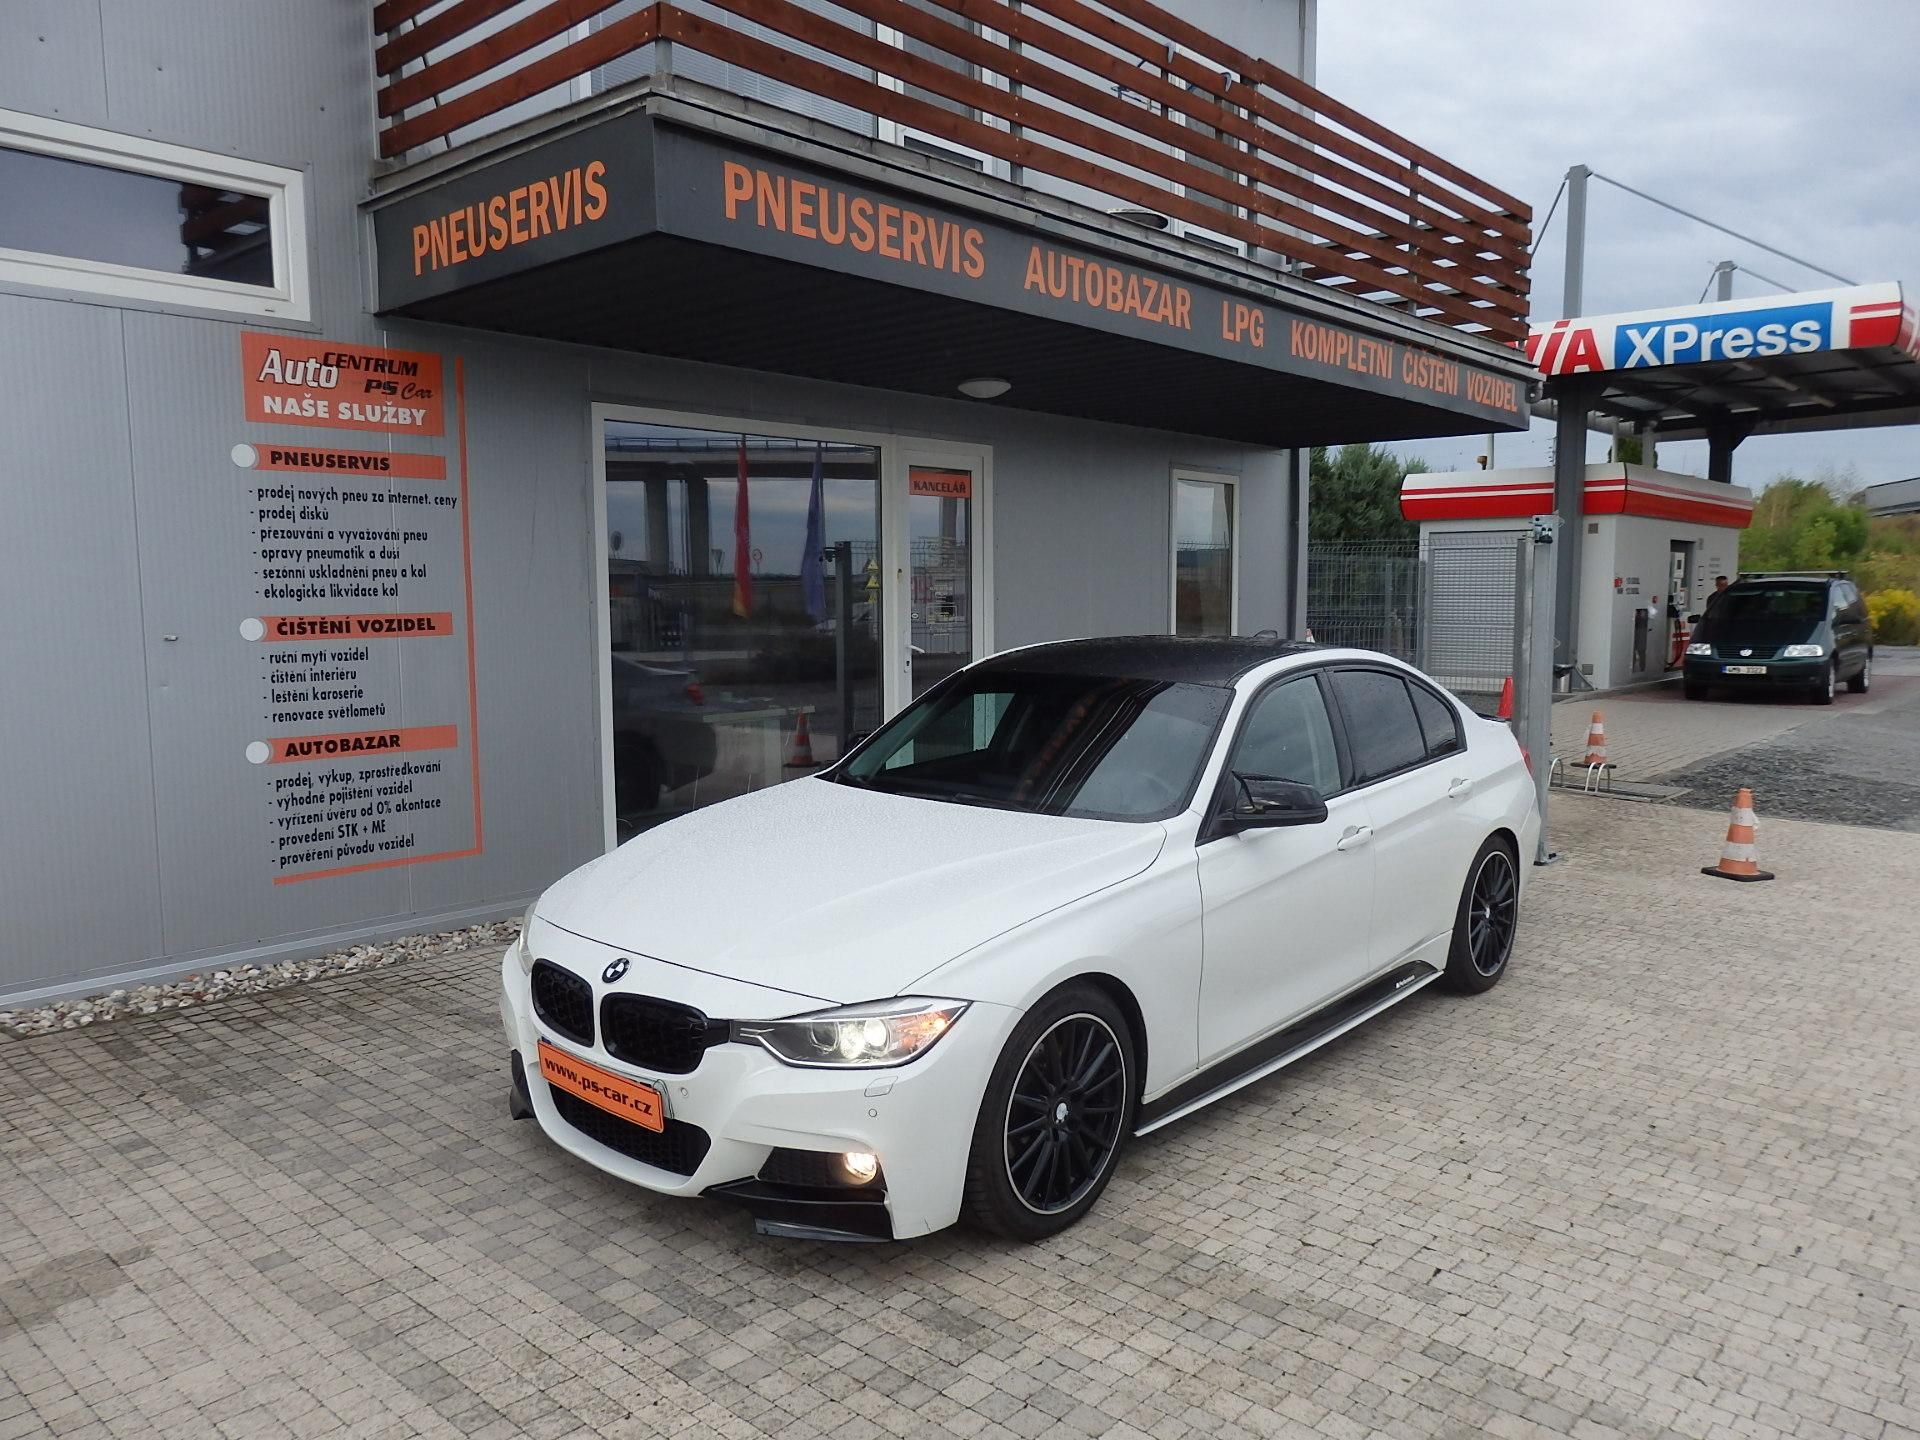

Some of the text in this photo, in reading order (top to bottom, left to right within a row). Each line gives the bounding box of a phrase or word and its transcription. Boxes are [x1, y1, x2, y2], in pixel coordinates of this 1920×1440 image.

[413, 160, 607, 276] PNEUSERVIS
[724, 161, 985, 278] PNEUSERVIS
[1024, 246, 1192, 330] AUTOBAZAR
[1222, 300, 1264, 347] LPG
[1291, 319, 1394, 379] KOMPLETNÍ
[1466, 370, 1518, 412] VOZIDEL
[1624, 318, 1822, 368] XPress
[256, 348, 418, 388] Auto CENTRUM
[364, 378, 399, 396] PS
[264, 393, 427, 426] NAŠE SLUŽBY
[270, 451, 390, 470] PNEUSERVIS
[258, 485, 294, 502] prodej
[298, 487, 338, 506] nových
[342, 490, 368, 504] pneu
[372, 492, 384, 502] za
[434, 494, 458, 509] ceny
[259, 506, 296, 523] prodej
[328, 532, 334, 540] a
[404, 531, 428, 543] pneu
[262, 549, 302, 562] opravy
[306, 544, 364, 562] pneumatik
[370, 551, 376, 559] a
[372, 568, 397, 580] pneu
[401, 570, 407, 578] a
[411, 564, 426, 578] kol
[264, 583, 398, 602] ekologická likvidace kol
[276, 616, 436, 636] ČIŠTĚNÍ VOZIDEL
[330, 646, 368, 662] vozidel
[312, 685, 364, 701] karoserie
[272, 710, 324, 723] renovace
[285, 734, 400, 757] AUTOBAZAR
[276, 772, 314, 792] prodej,
[377, 780, 413, 795] vozidel
[361, 802, 374, 816] od
[376, 800, 392, 814] 0%
[396, 797, 442, 812] akontace
[279, 827, 335, 850] provedení
[338, 822, 358, 839] STK
[372, 820, 386, 834] ME
[378, 834, 415, 850] vozidel
[544, 1058, 653, 1116] www.ps-car.cz
